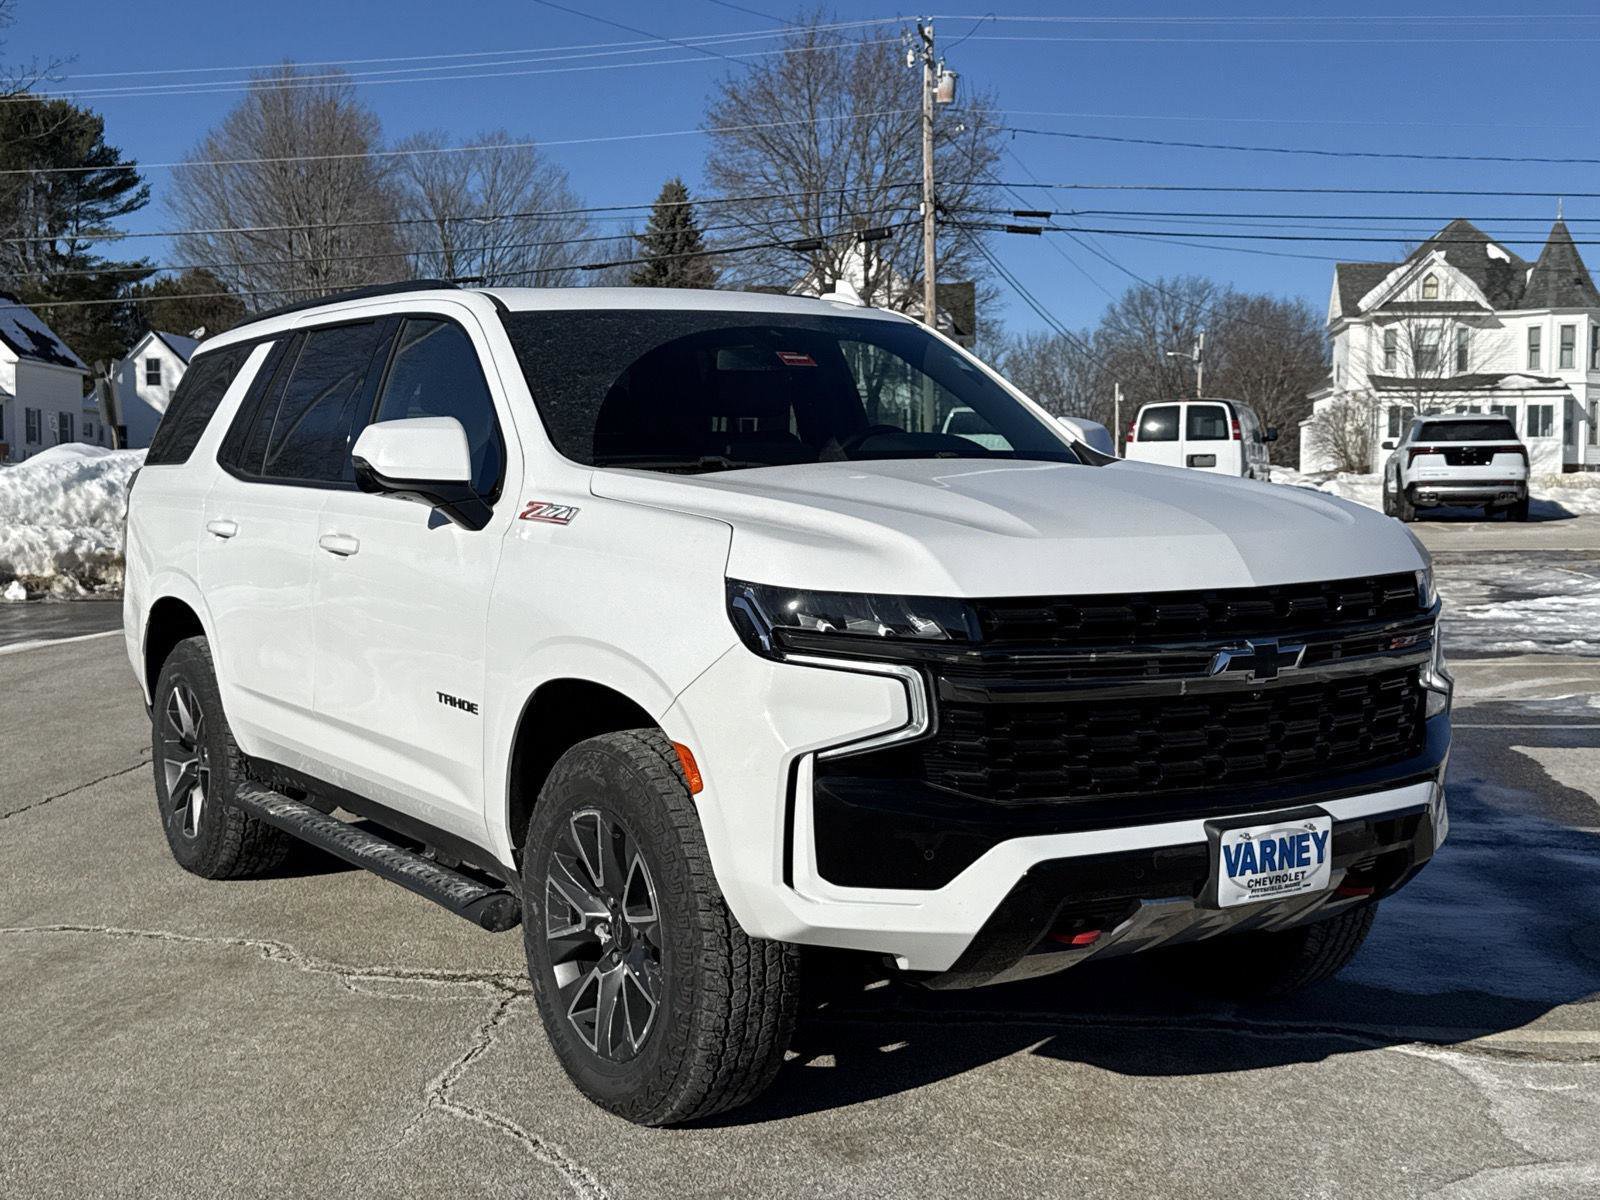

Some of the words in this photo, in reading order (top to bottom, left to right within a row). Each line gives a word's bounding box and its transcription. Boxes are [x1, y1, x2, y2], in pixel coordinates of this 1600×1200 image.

[519, 501, 580, 525] Z71
[436, 691, 479, 716] TAHOE
[1222, 830, 1329, 878] VARNEY
[1247, 871, 1306, 889] CHEVROLET
